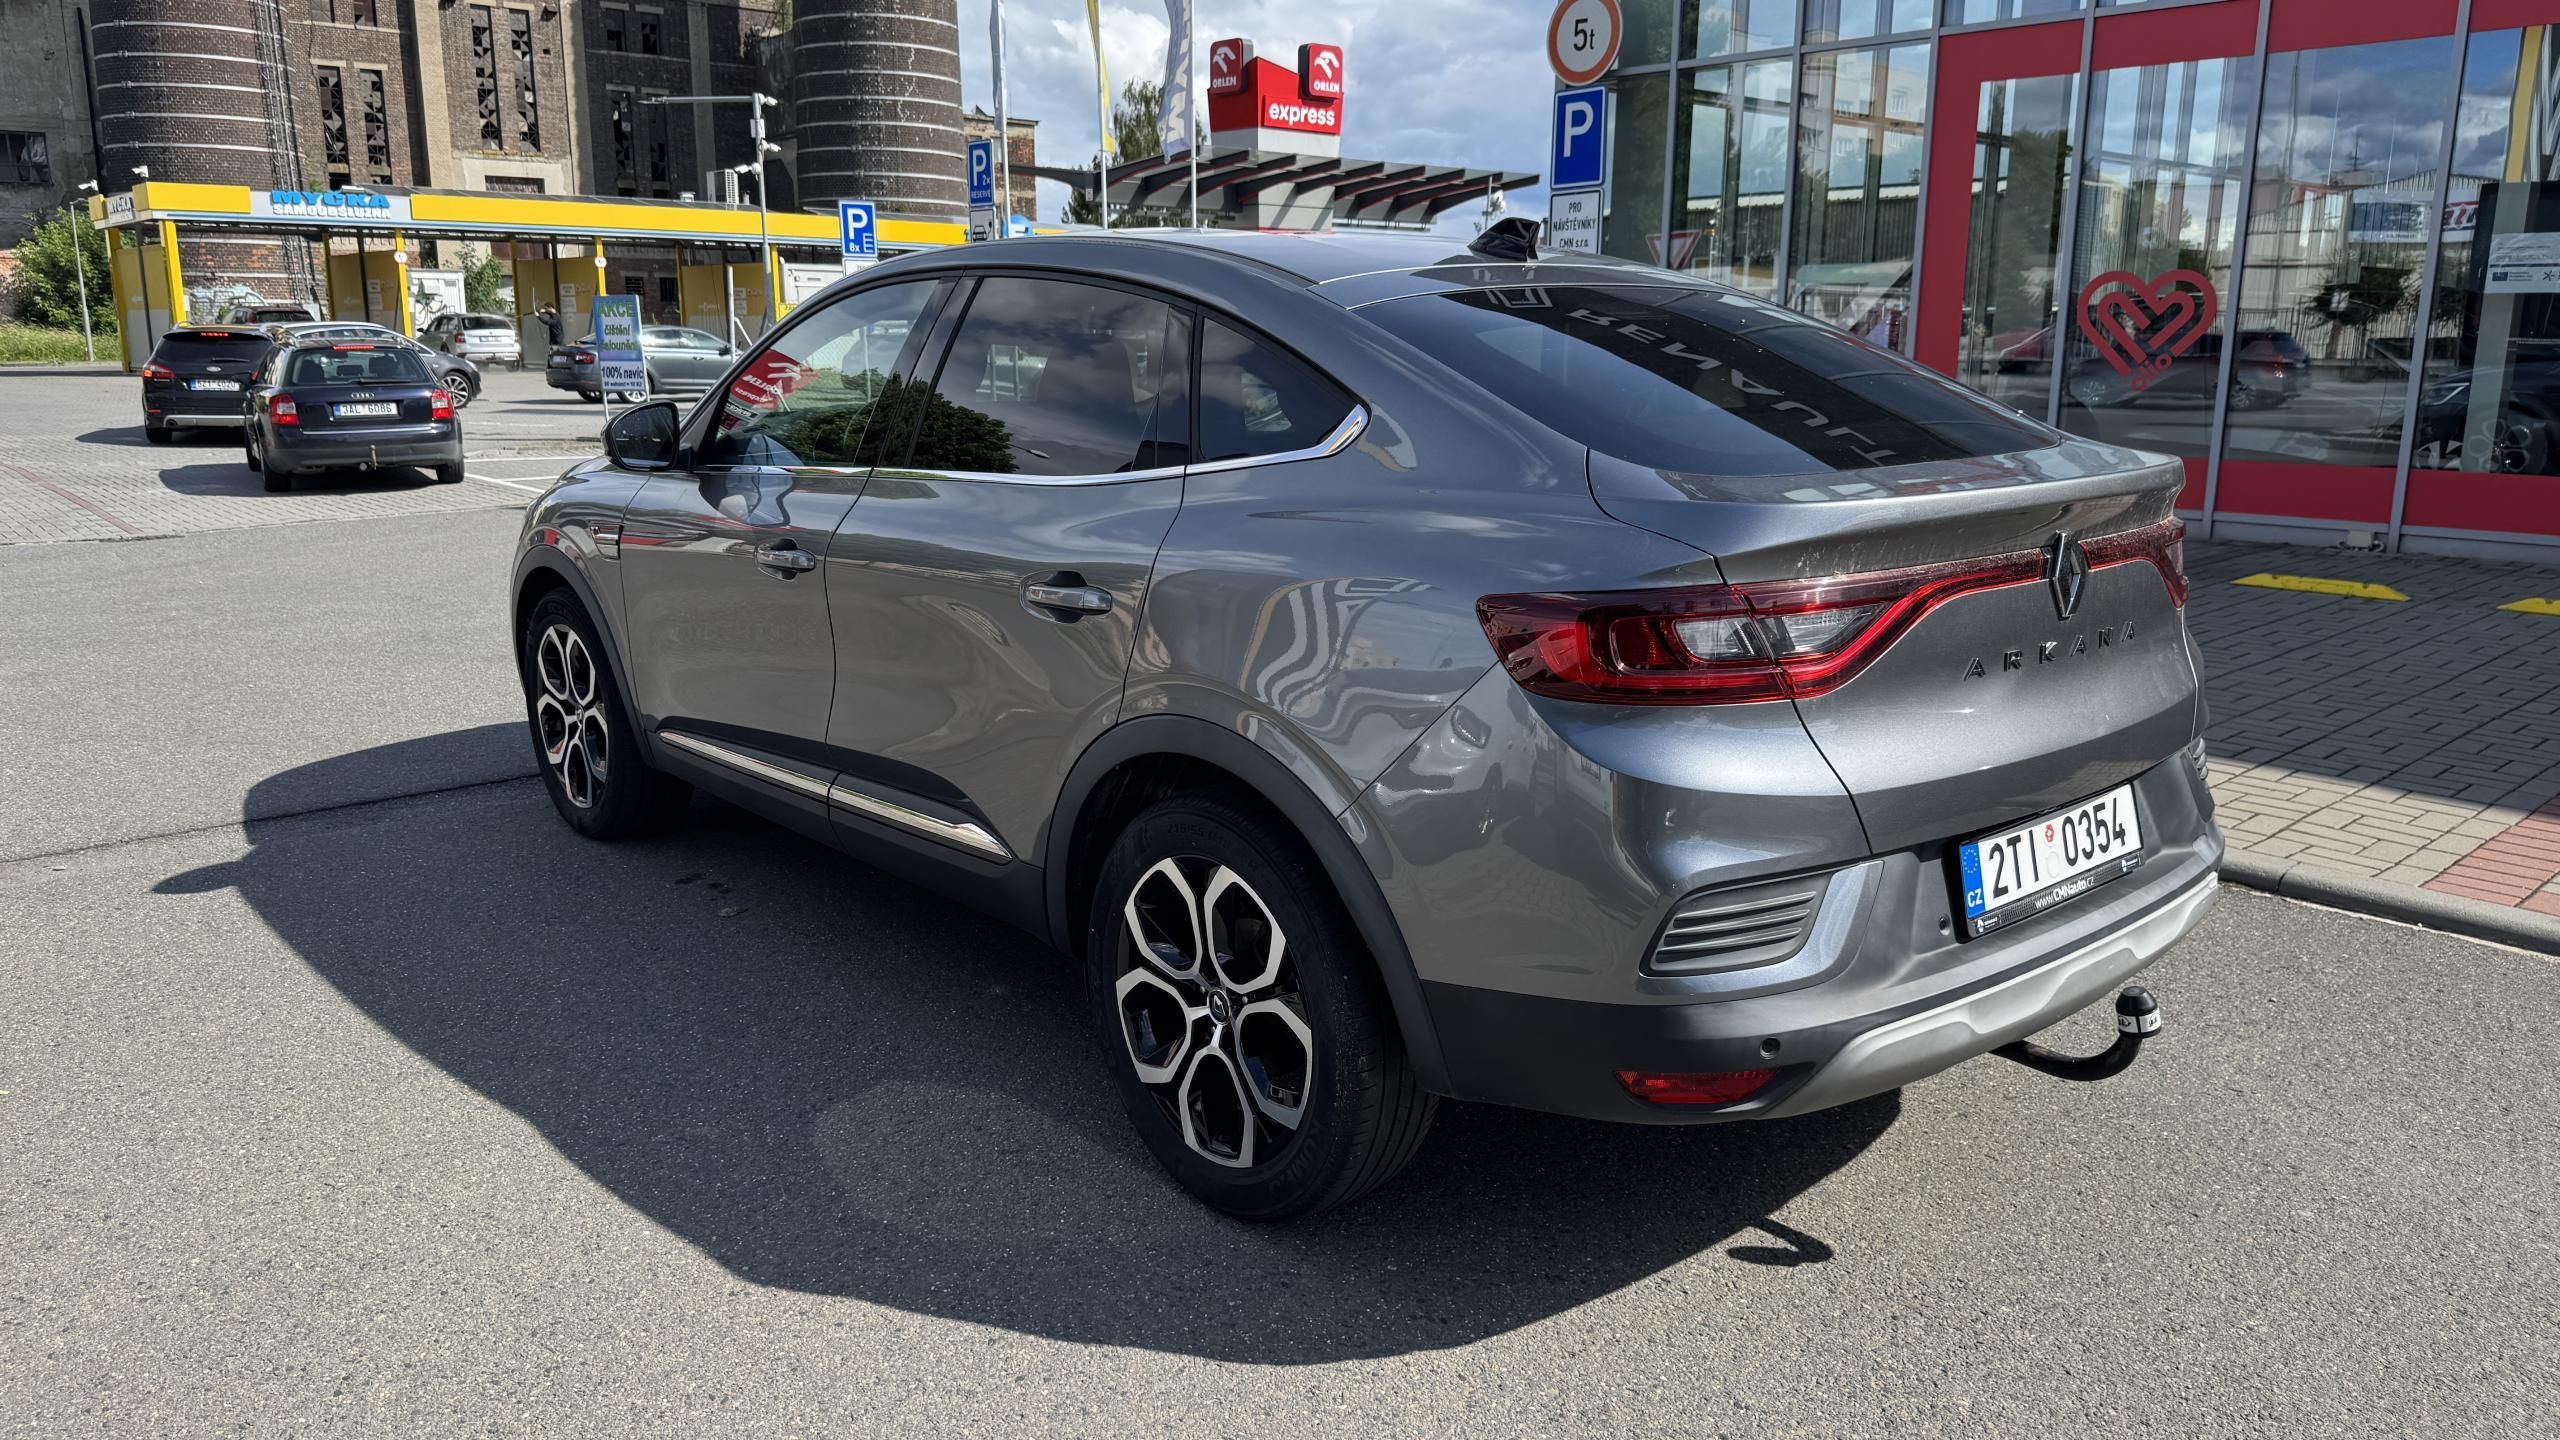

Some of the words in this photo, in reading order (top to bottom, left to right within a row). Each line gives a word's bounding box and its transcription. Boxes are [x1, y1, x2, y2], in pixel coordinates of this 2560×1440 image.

[1573, 18, 1595, 51] 5t
[1212, 75, 1237, 88] ORLEN
[1313, 80, 1340, 93] ORLEN
[1268, 102, 1336, 126] express
[1563, 101, 1594, 158] P
[972, 149, 987, 187] P
[982, 174, 991, 185] 2x
[1568, 201, 1582, 213] PRO
[847, 208, 869, 240] P
[1552, 216, 1597, 233] NÁVŠTĚVNÍKY
[849, 242, 860, 253] 8x
[1559, 237, 1574, 249] CMN
[598, 302, 634, 317] AKCE
[601, 366, 622, 379] 100%
[624, 366, 644, 379] navíc
[342, 404, 361, 415] 3AL
[1962, 620, 2136, 681] ARKANA
[1988, 829, 2040, 899] 2TI
[2061, 797, 2127, 867] 0354
[1967, 887, 1983, 908] CZ
